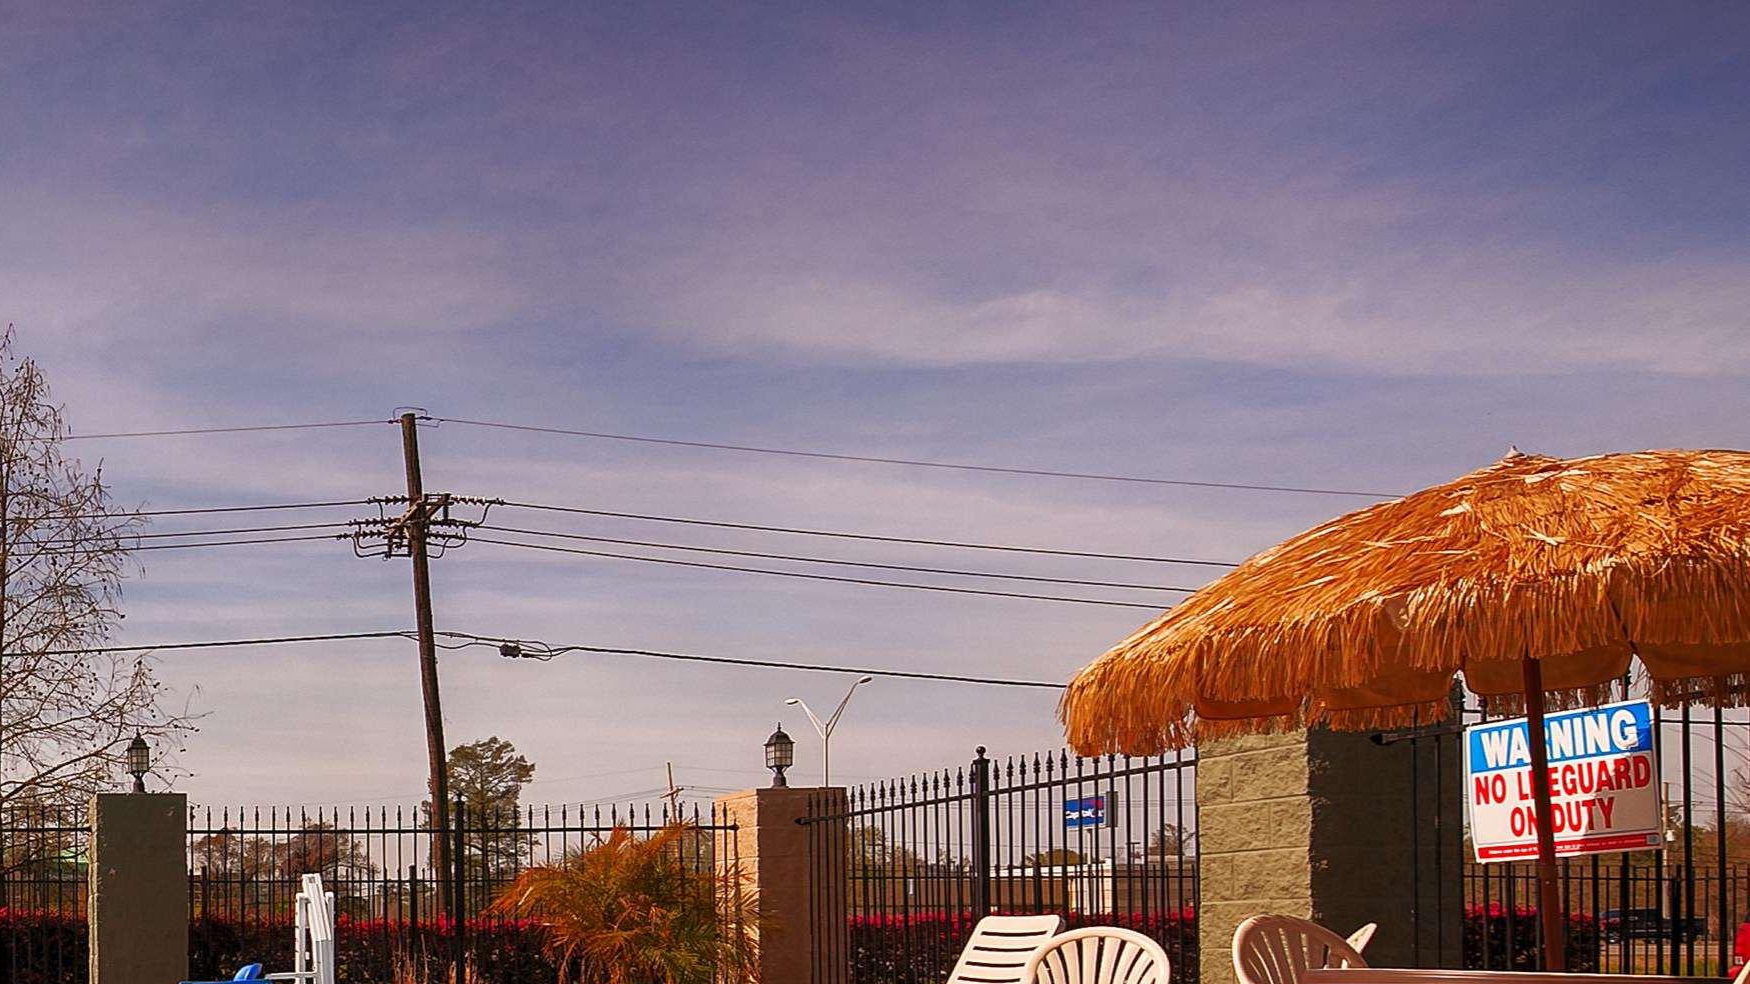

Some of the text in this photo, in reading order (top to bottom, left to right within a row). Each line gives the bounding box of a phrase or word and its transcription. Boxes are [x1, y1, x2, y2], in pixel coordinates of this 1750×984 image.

[1481, 709, 1639, 769] WANING
[1475, 755, 1651, 806] NO LIEGUARD
[1510, 796, 1616, 837] ON DUTY
